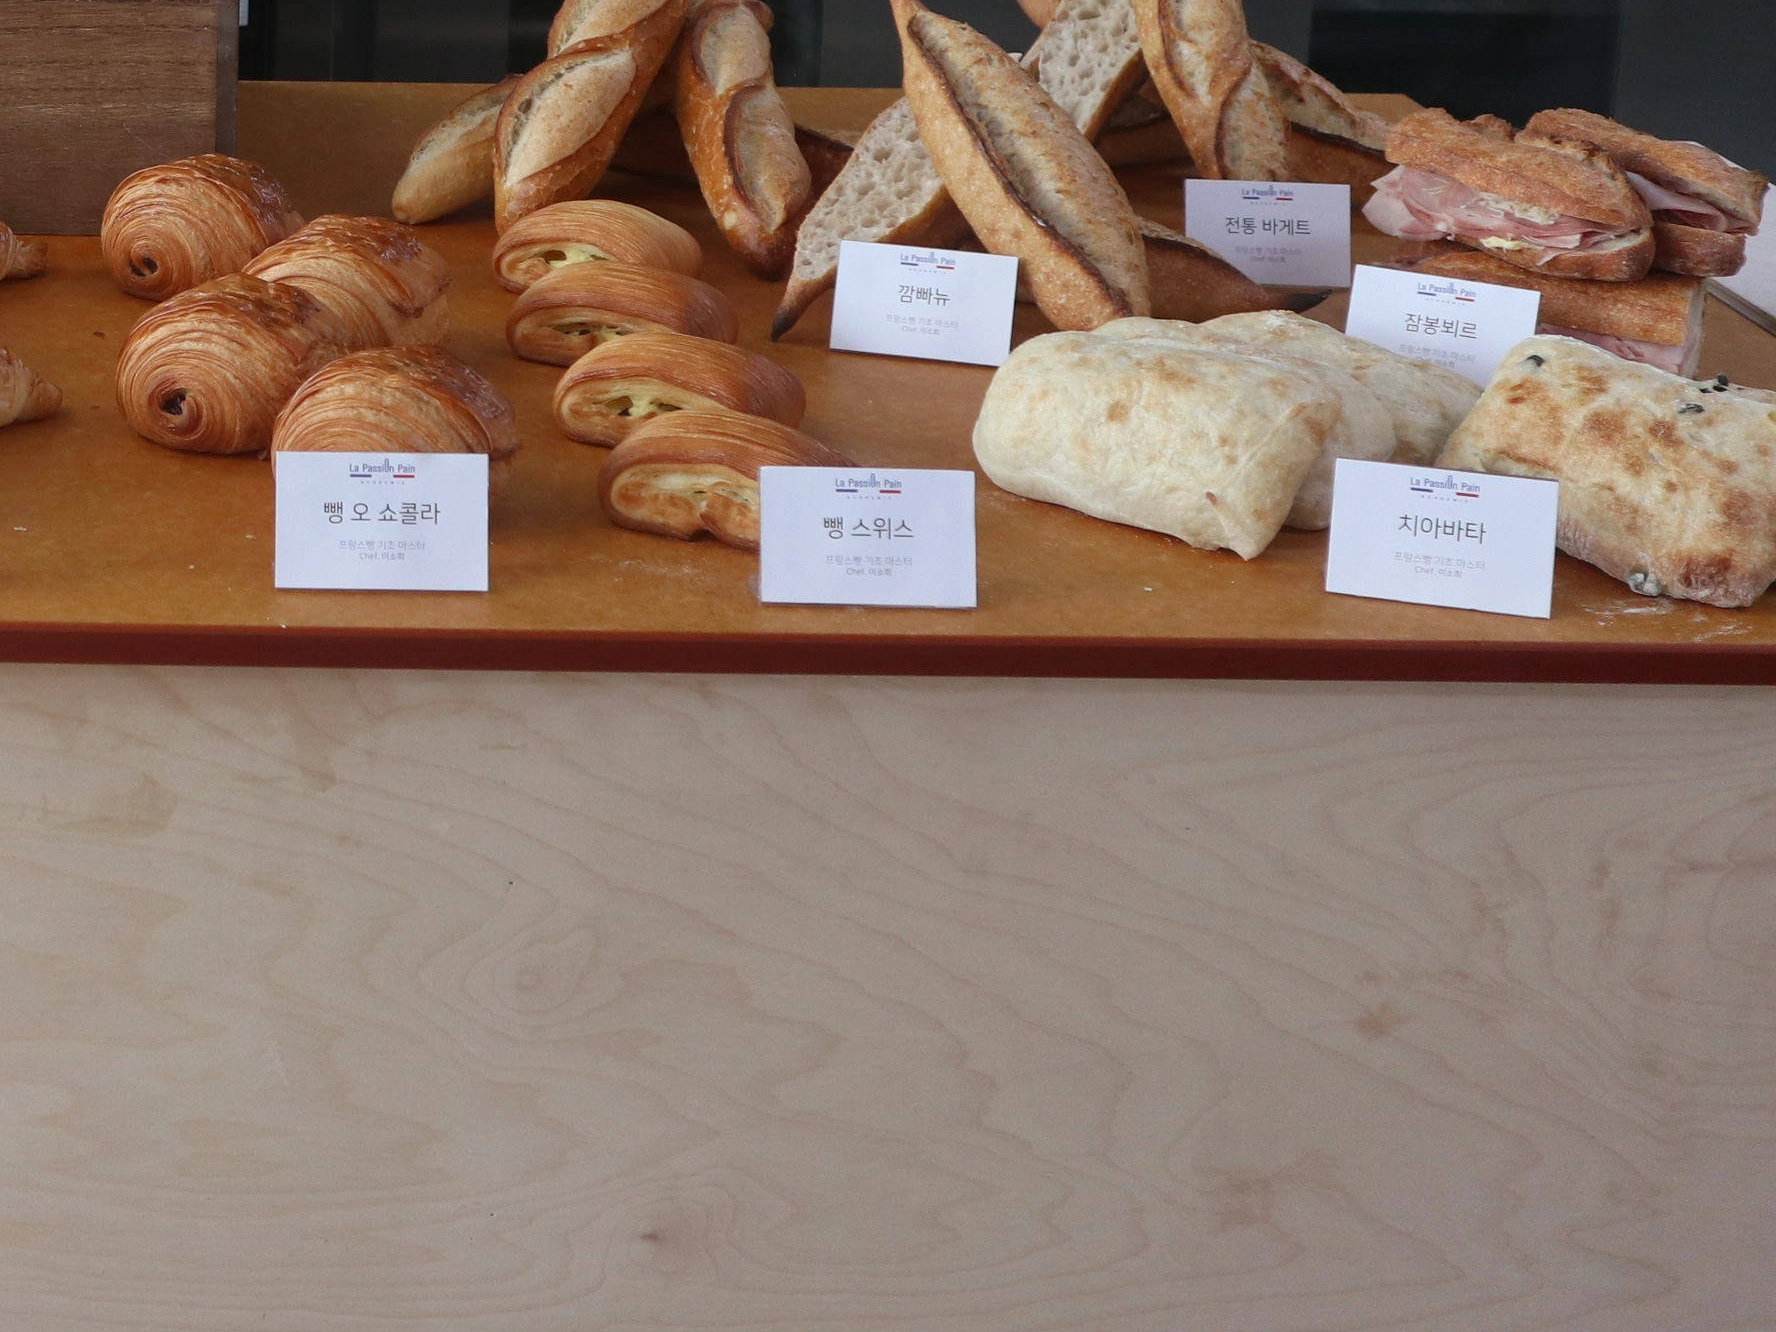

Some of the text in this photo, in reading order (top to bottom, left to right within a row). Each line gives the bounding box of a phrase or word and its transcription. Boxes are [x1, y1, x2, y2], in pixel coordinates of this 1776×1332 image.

[1225, 217, 1311, 236] 전통 바게트
[900, 252, 956, 266] La Passion Pain
[898, 285, 951, 306] 깜빠뉴
[1417, 282, 1476, 298] La Passion Pain
[1404, 313, 1477, 339] 잠봉뵈르
[349, 458, 416, 474] La Passion Pain
[835, 473, 902, 488] La Passion Pain
[1410, 475, 1480, 493] La Passion Pain
[324, 501, 441, 525] 뺑 오 쇼콜라
[823, 517, 914, 540] 뺑 스위스
[1398, 514, 1487, 545] 치아바타
